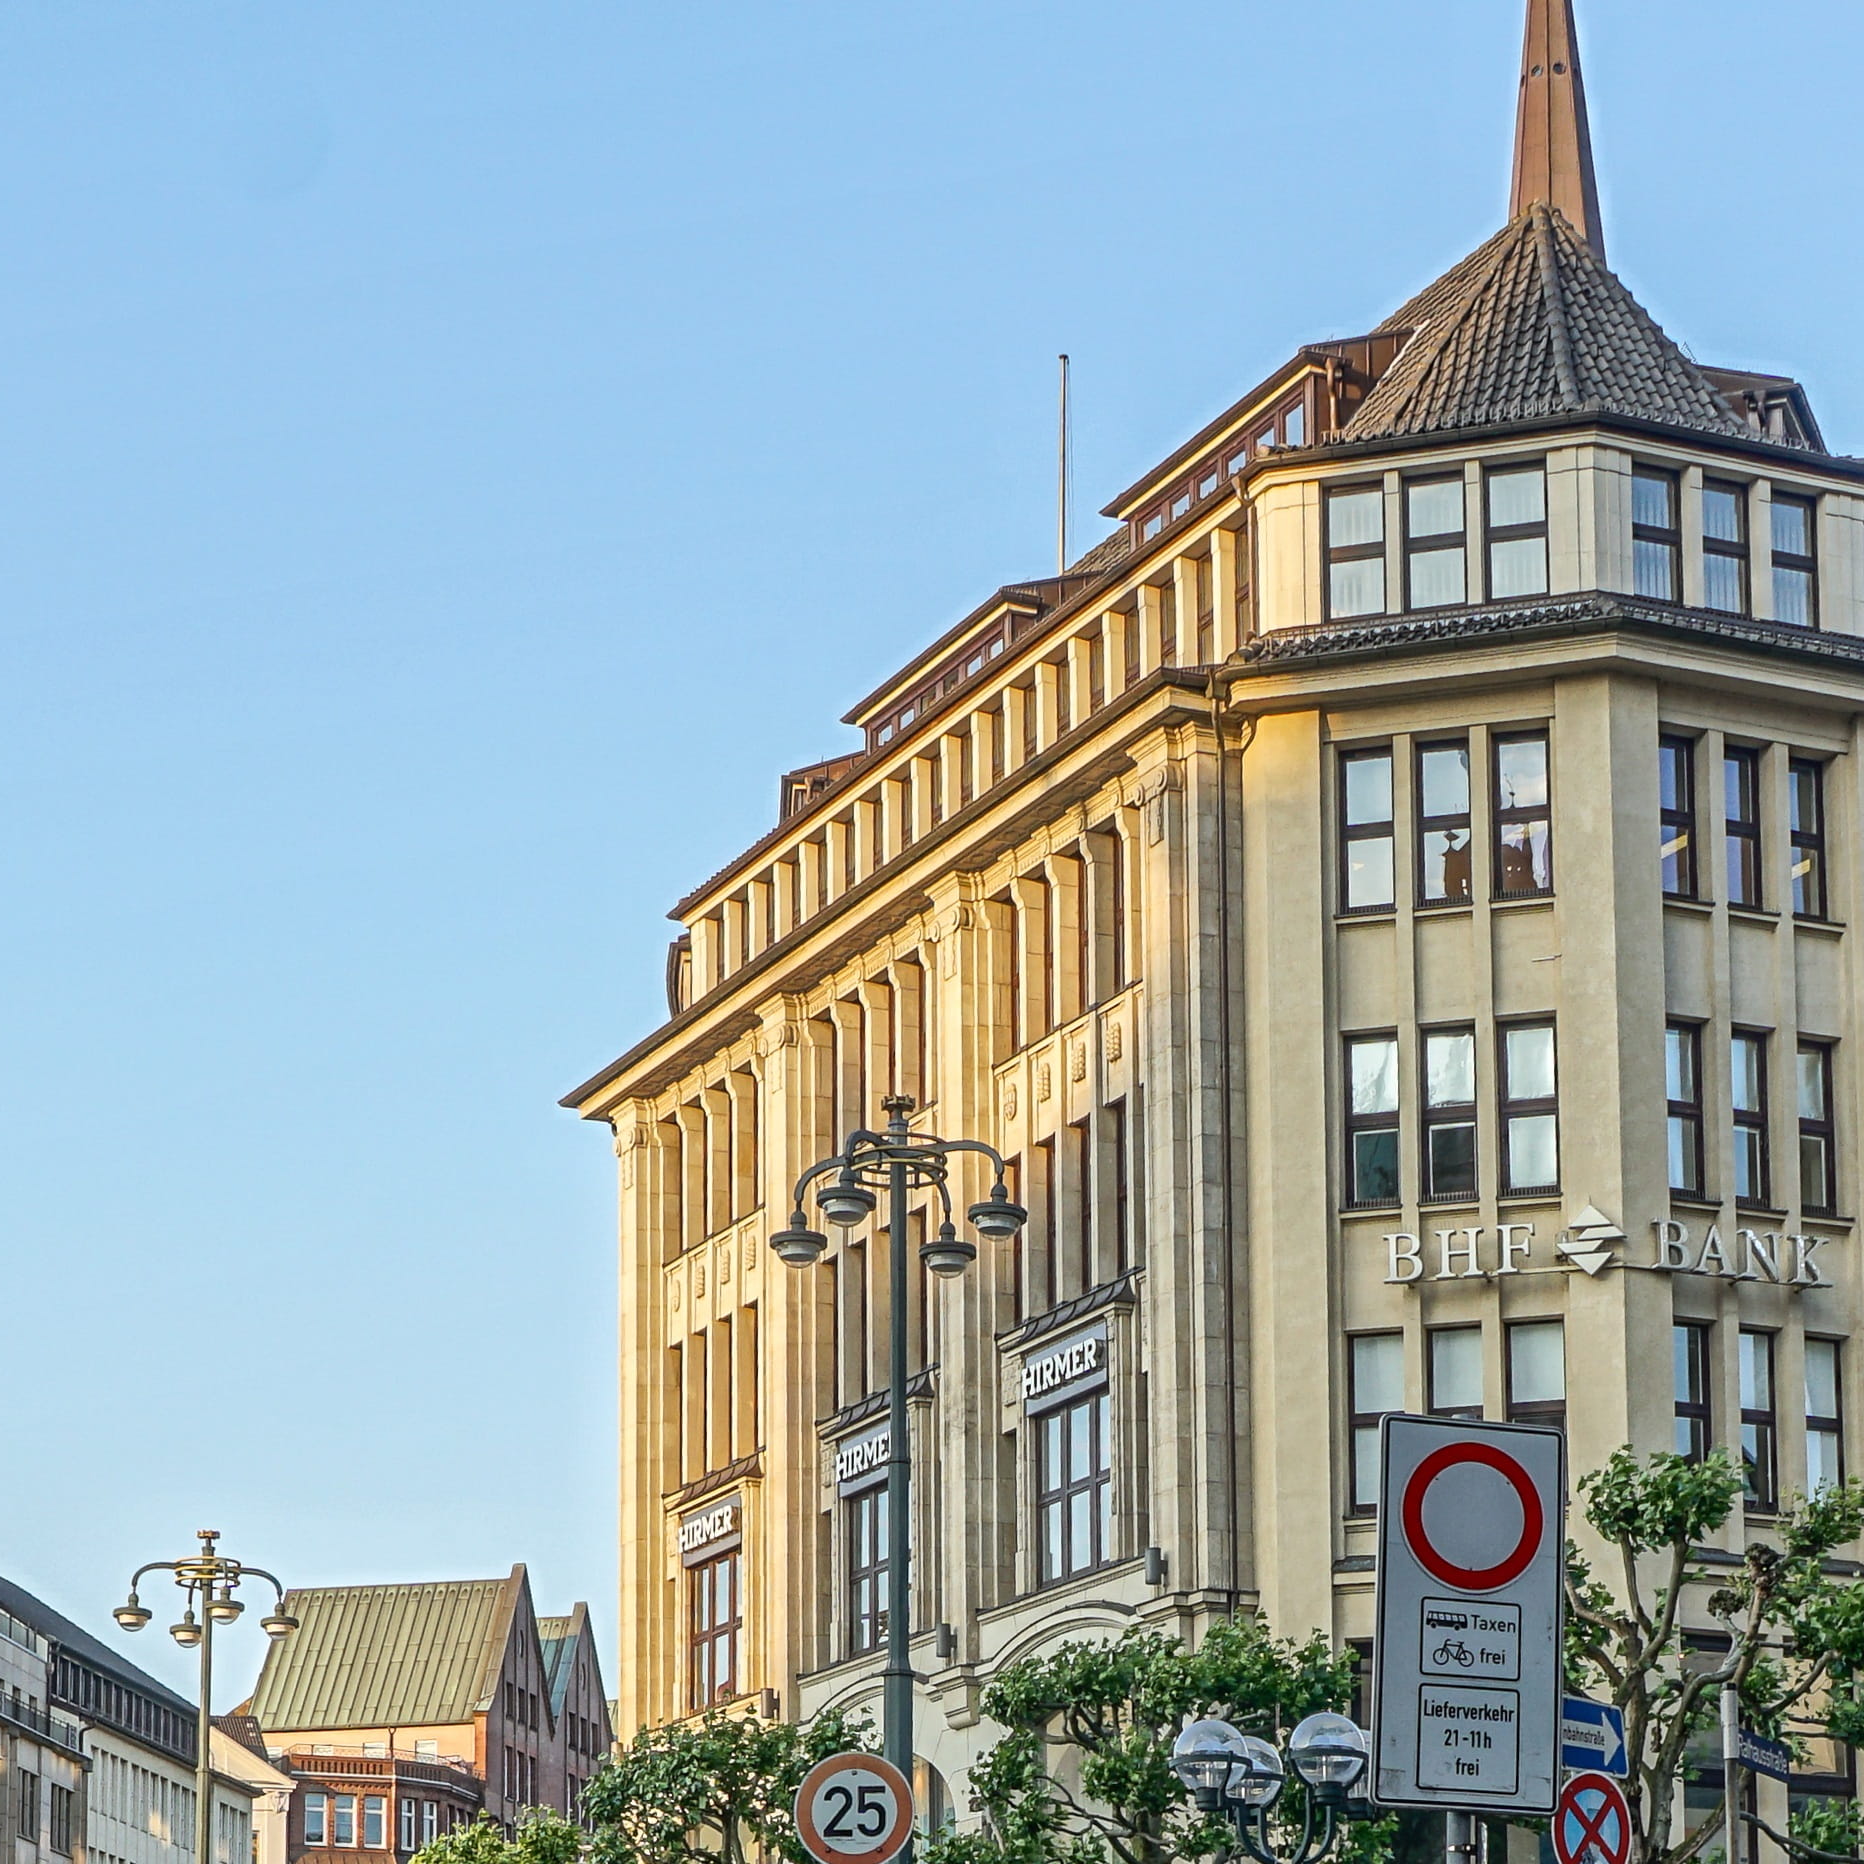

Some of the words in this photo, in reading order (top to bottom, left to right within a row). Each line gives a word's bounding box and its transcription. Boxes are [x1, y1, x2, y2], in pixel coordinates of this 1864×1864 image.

[1382, 1222, 1535, 1284] BHF
[1650, 1216, 1834, 1289] BANK
[1022, 1337, 1097, 1399] HIRMER
[835, 1430, 890, 1481] HIRME
[679, 1504, 732, 1554] HIRMER
[1471, 1614, 1516, 1633] Taxen
[1480, 1648, 1506, 1665] frei
[1423, 1699, 1514, 1722] Lieferverkehr
[1455, 1757, 1479, 1776] frei
[1738, 1733, 1787, 1774] Rathausstraße
[823, 1786, 886, 1837] 25
